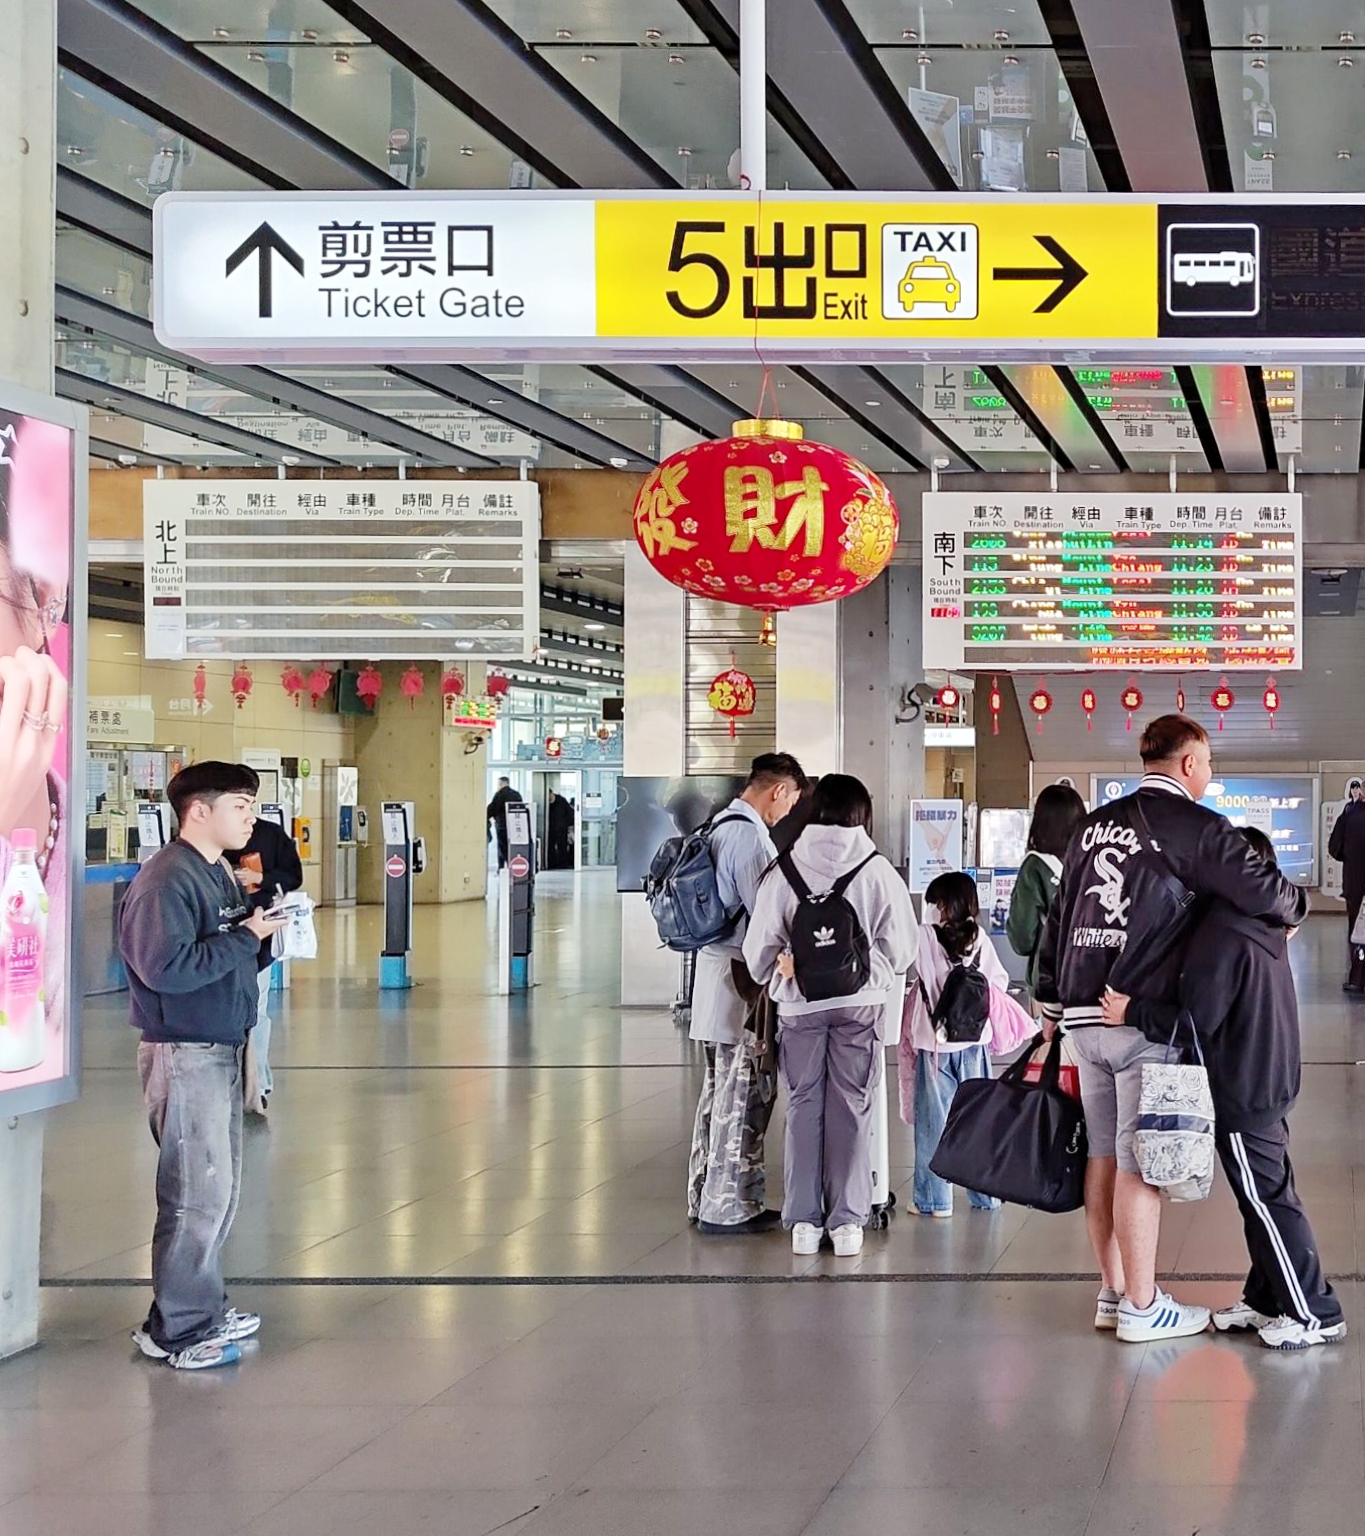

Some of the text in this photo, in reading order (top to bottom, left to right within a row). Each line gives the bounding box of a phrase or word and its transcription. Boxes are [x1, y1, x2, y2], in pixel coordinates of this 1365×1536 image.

[318, 220, 496, 279] 剪票口
[893, 231, 967, 253] TAXI
[665, 220, 868, 320] 5出口
[318, 287, 525, 319] Ticket Gate
[823, 292, 868, 320] Exit
[196, 493, 514, 508] 車次 開往 經由 車種 時間 月台 備註
[191, 508, 212, 516] Train
[236, 508, 288, 516] Destination
[305, 508, 320, 516] Via
[338, 508, 360, 516] Train
[362, 508, 385, 517] Type
[418, 508, 440, 516] Time
[445, 508, 465, 516] Plat.
[478, 508, 518, 517] Remarks
[973, 505, 1288, 521] 車次 開往 經由 車種 時間 月台 備註
[968, 520, 989, 528] Train
[1013, 521, 1064, 529] Destination
[1079, 521, 1094, 529] Via
[1116, 521, 1141, 529] Train
[1142, 521, 1162, 530] Type
[1192, 520, 1213, 529] Time
[1253, 521, 1292, 529] Remarks
[154, 519, 178, 565] 北上
[933, 532, 956, 576] 南下
[151, 566, 183, 575] North
[151, 575, 183, 584] Bound
[929, 578, 961, 586] South
[929, 587, 961, 596] Bound
